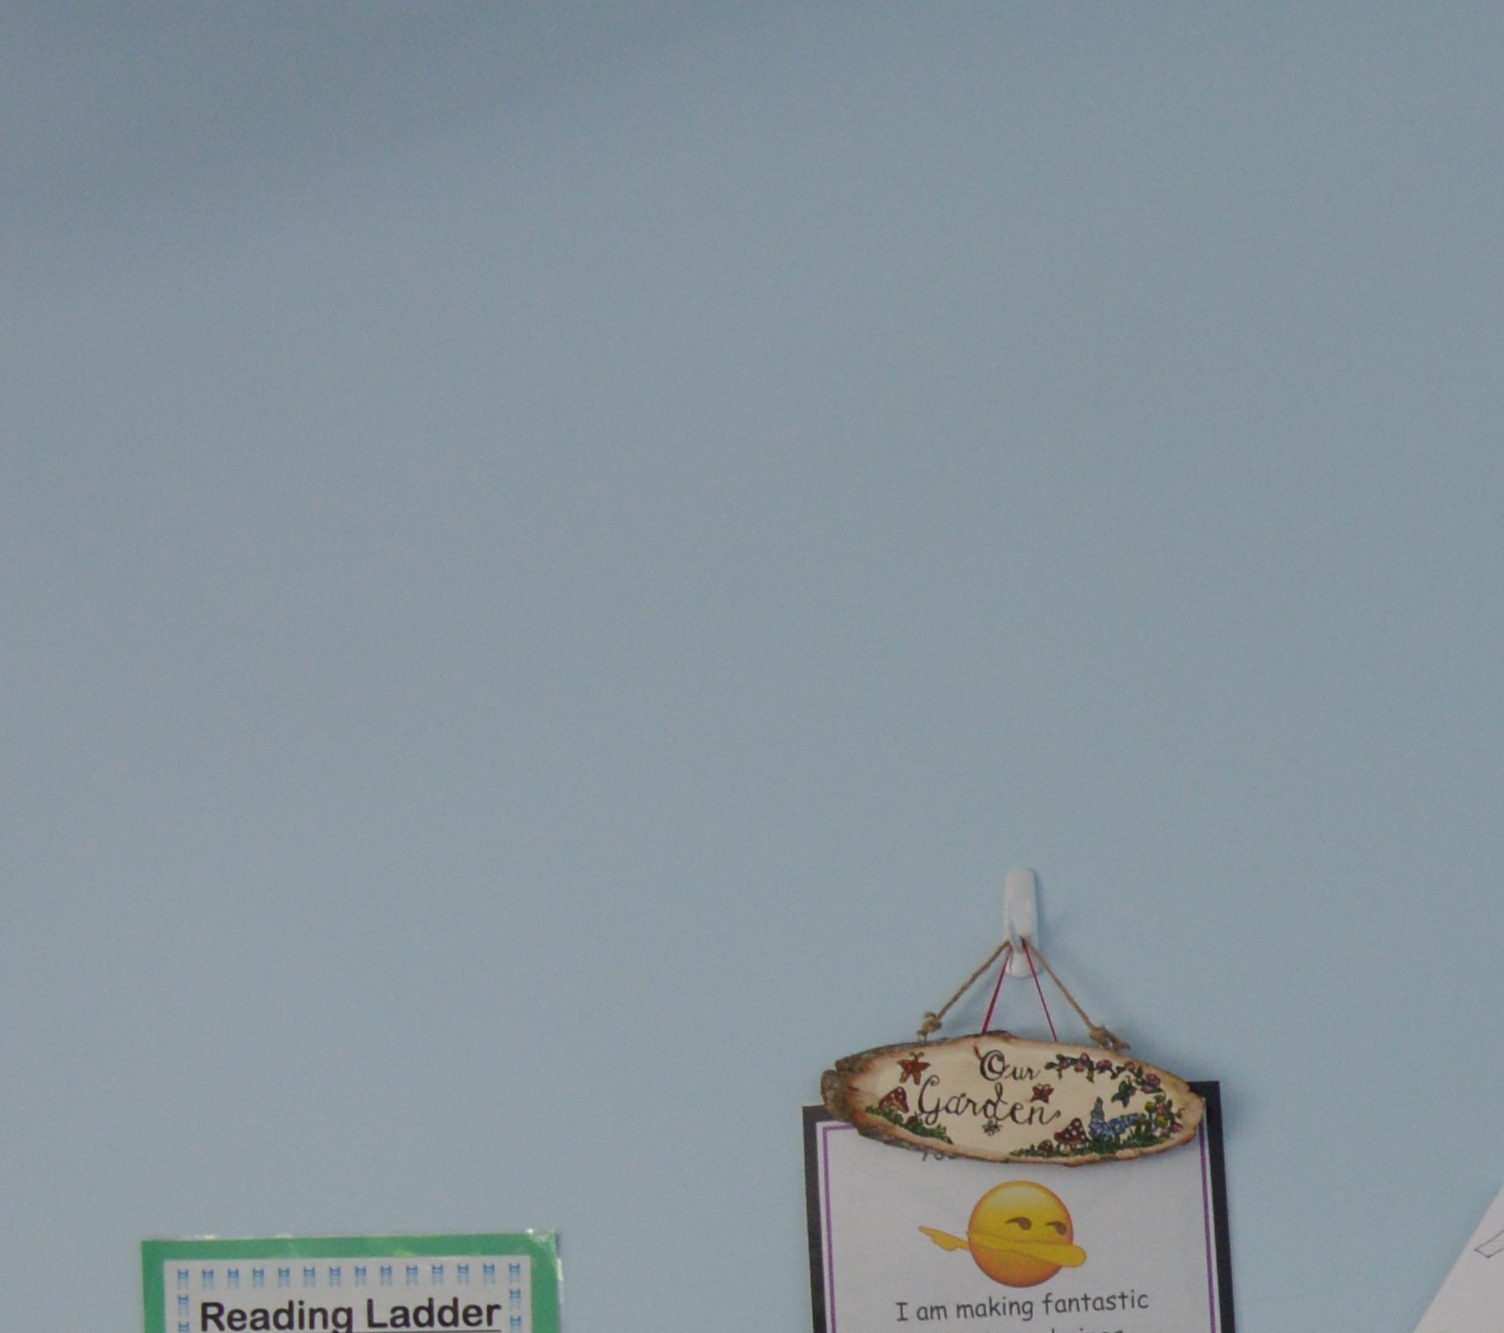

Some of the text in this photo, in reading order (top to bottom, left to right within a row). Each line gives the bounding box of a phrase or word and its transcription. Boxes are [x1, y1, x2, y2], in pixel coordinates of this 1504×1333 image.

[979, 1049, 1042, 1081] Our
[918, 1074, 1062, 1127] Garden
[366, 1298, 501, 1330] Ladder
[896, 1289, 1150, 1321] I am making fantastic
